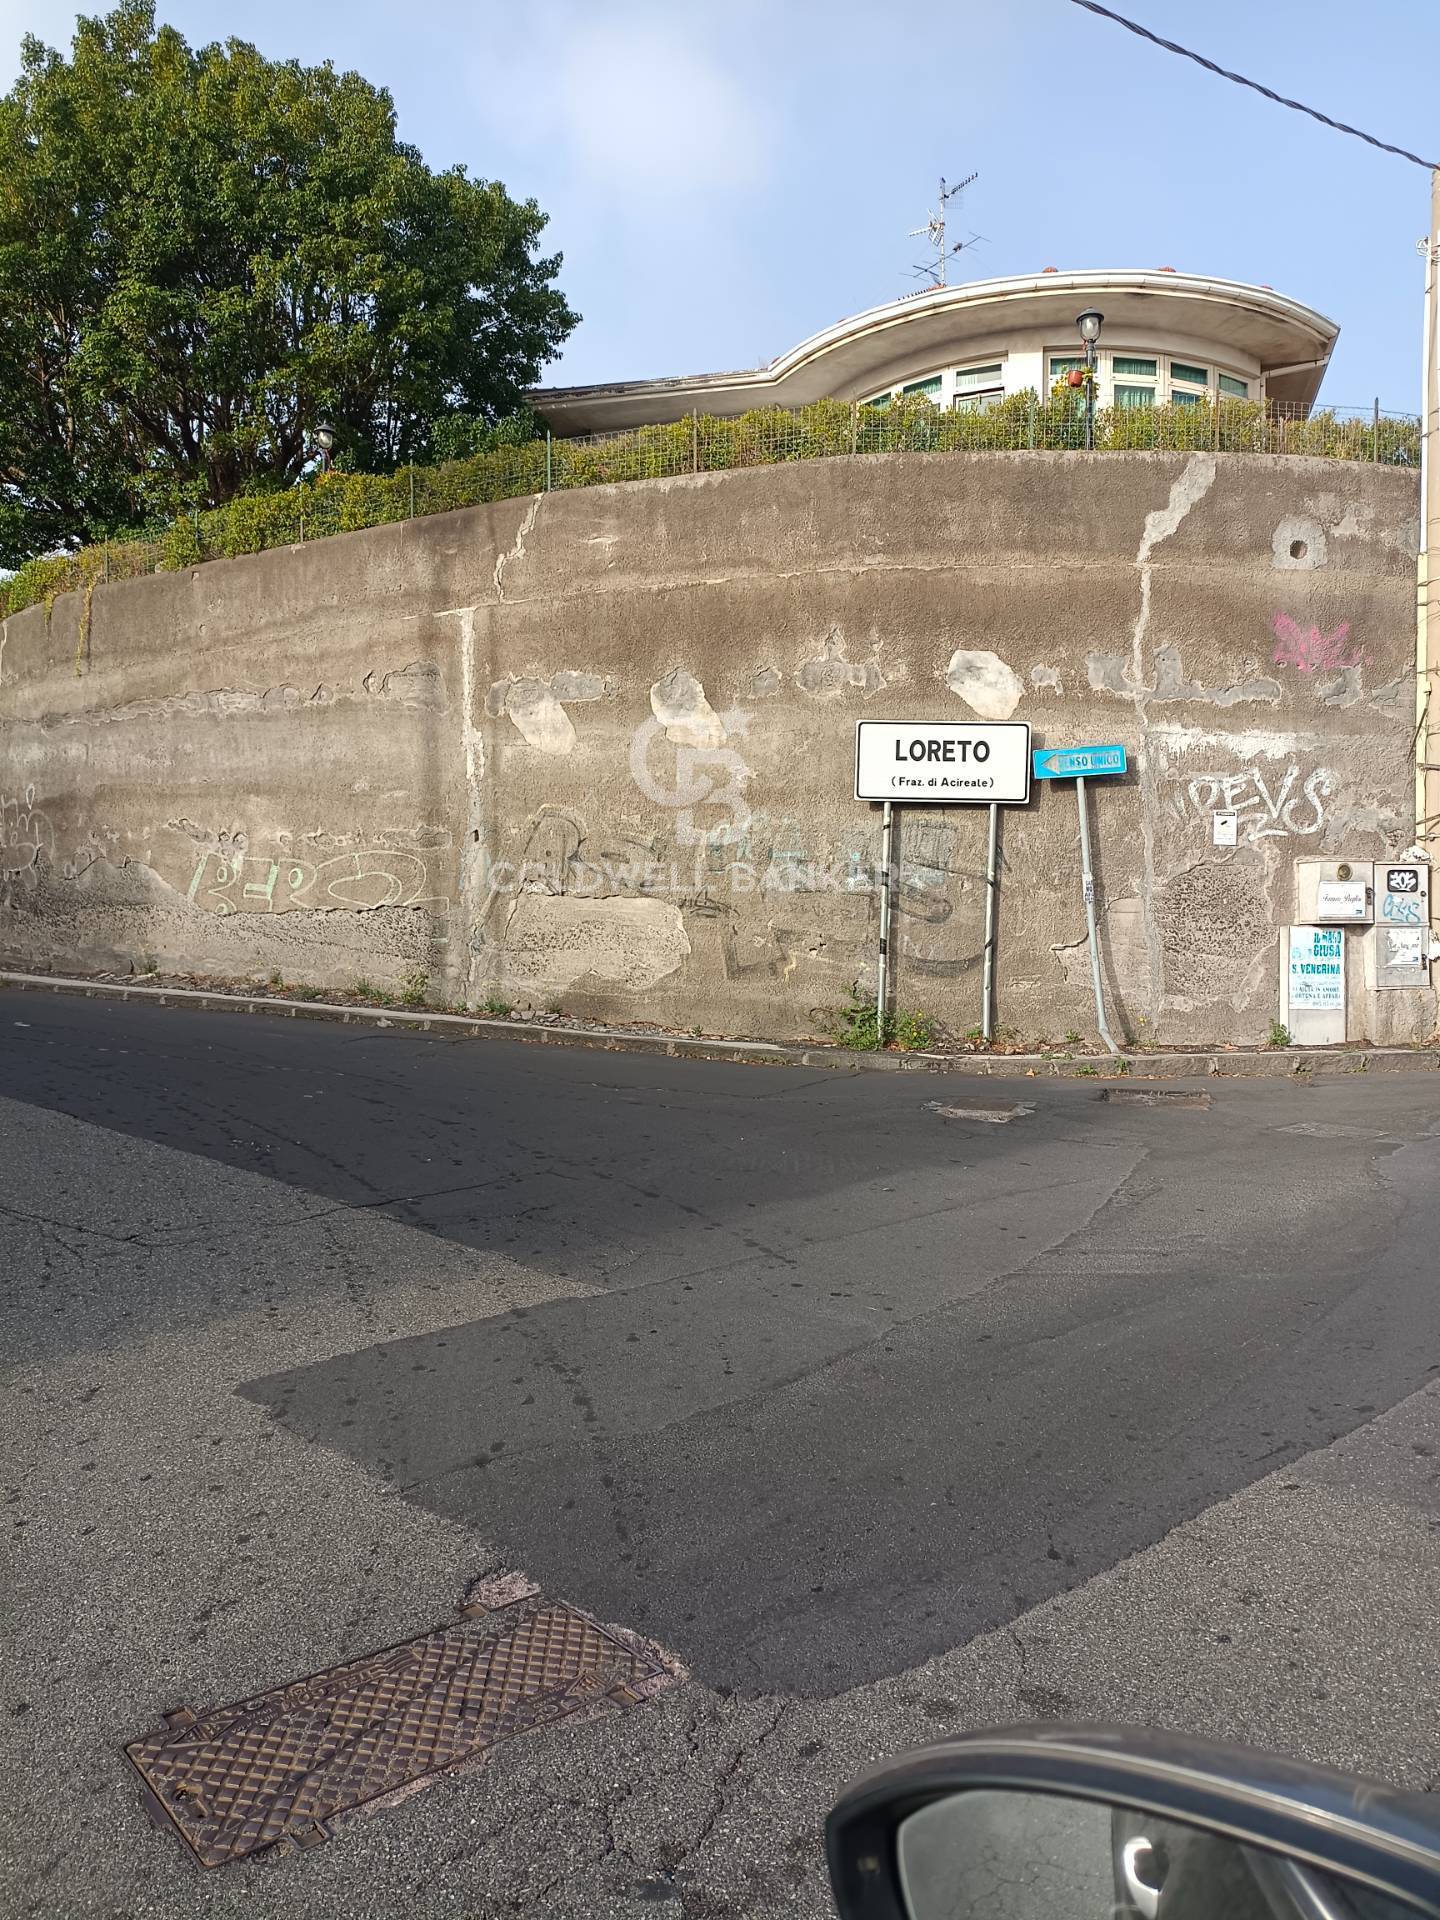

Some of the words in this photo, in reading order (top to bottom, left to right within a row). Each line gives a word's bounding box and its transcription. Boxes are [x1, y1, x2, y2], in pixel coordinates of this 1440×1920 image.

[895, 739, 990, 763] LORETO
[890, 776, 925, 787] (Fraz.
[927, 777, 937, 787] di
[940, 777, 994, 788] Acireale)
[1313, 944, 1341, 957] GIUSA
[1300, 963, 1341, 974] VENERINA
